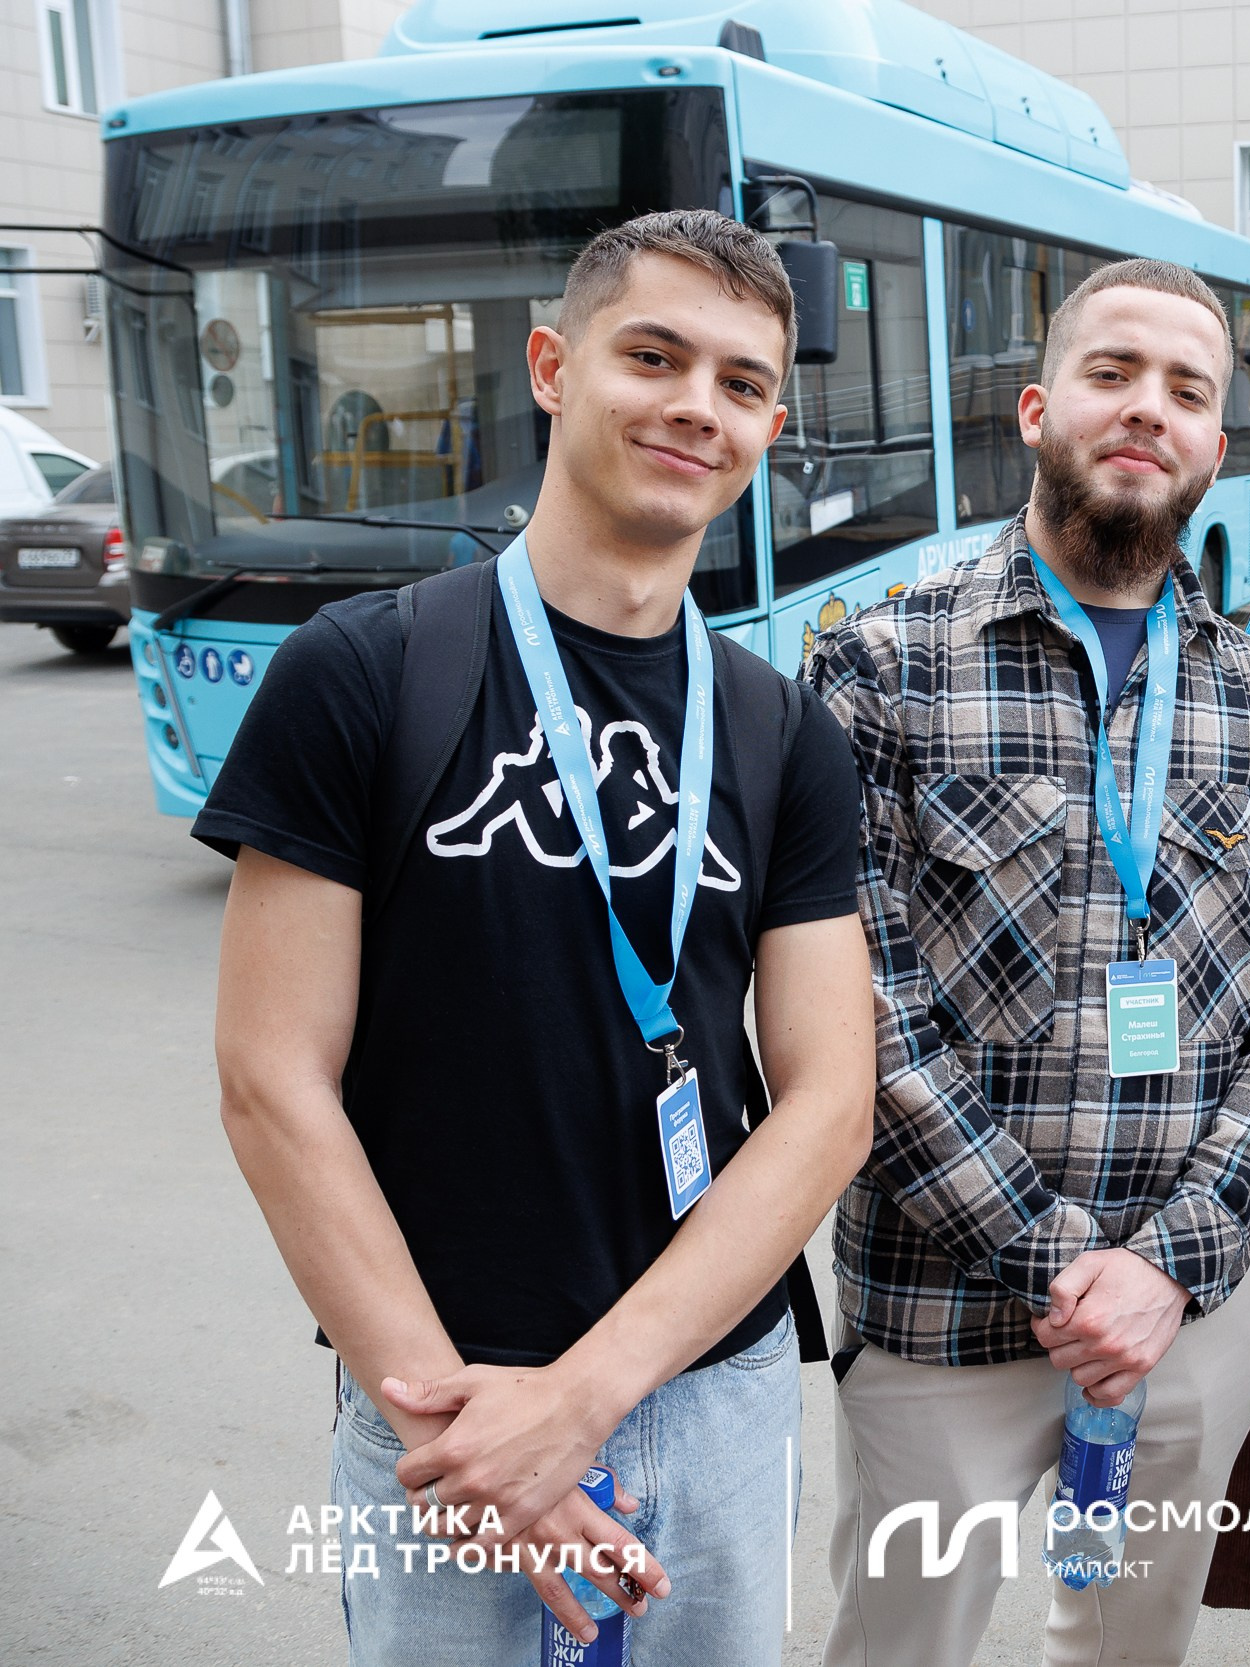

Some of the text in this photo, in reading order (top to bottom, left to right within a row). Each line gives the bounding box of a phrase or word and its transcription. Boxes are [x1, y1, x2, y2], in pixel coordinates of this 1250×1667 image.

[1126, 997, 1160, 1006] УЧАСТНИК
[1128, 1020, 1158, 1030] Малеш
[1121, 1033, 1165, 1042] Страхинья
[1129, 1049, 1159, 1057] Белгород
[554, 1623, 590, 1648] Кн
